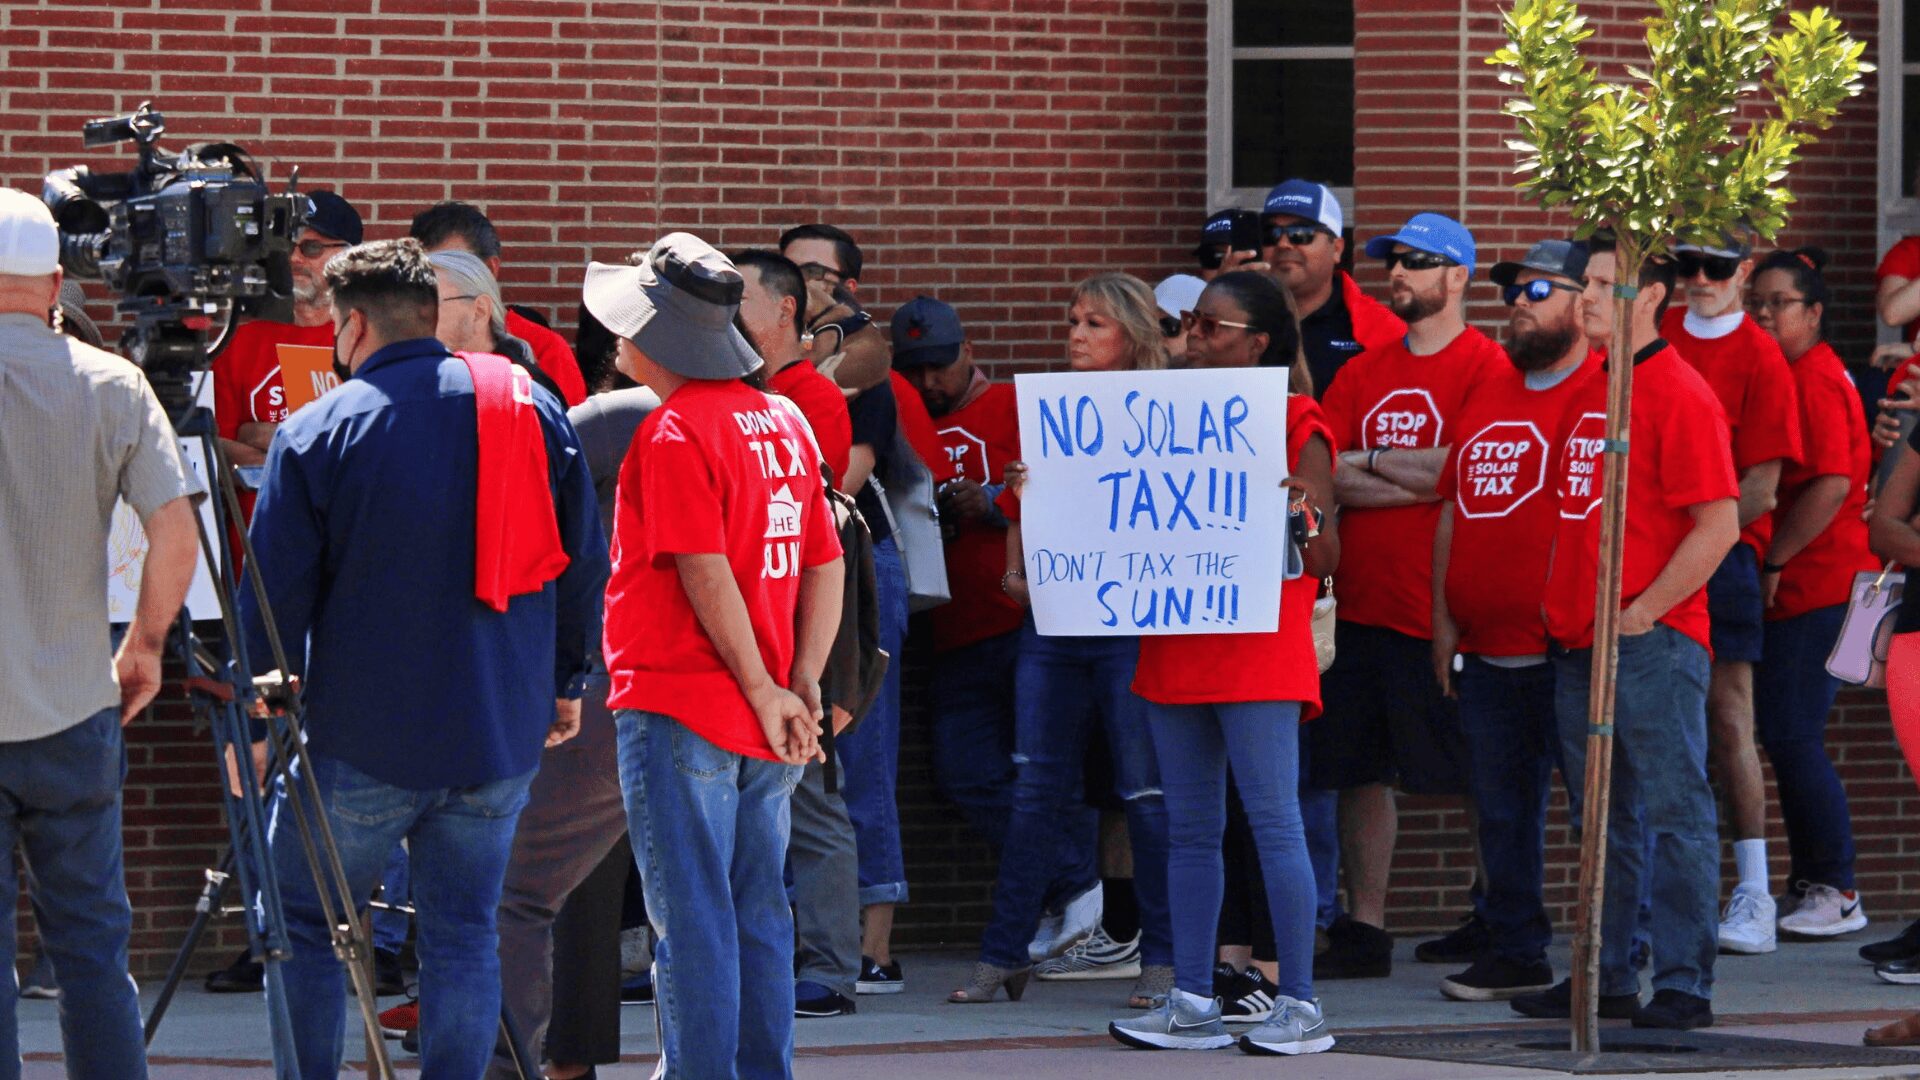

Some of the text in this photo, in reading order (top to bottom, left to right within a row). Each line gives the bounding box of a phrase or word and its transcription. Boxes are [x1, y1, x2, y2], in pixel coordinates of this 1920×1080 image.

[1039, 390, 1256, 458] NO SOLAR
[1376, 411, 1427, 432] STOP
[749, 438, 807, 479] TAX
[1470, 440, 1530, 460] STOP
[1476, 461, 1518, 475] SOLAR
[1569, 460, 1595, 474] SOL
[1473, 475, 1517, 497] TAX
[1567, 475, 1592, 497] TA
[1098, 467, 1247, 533] TAX!!!
[1032, 548, 1239, 586] DON'T TAX THE
[1097, 581, 1239, 629] SUN!!!
